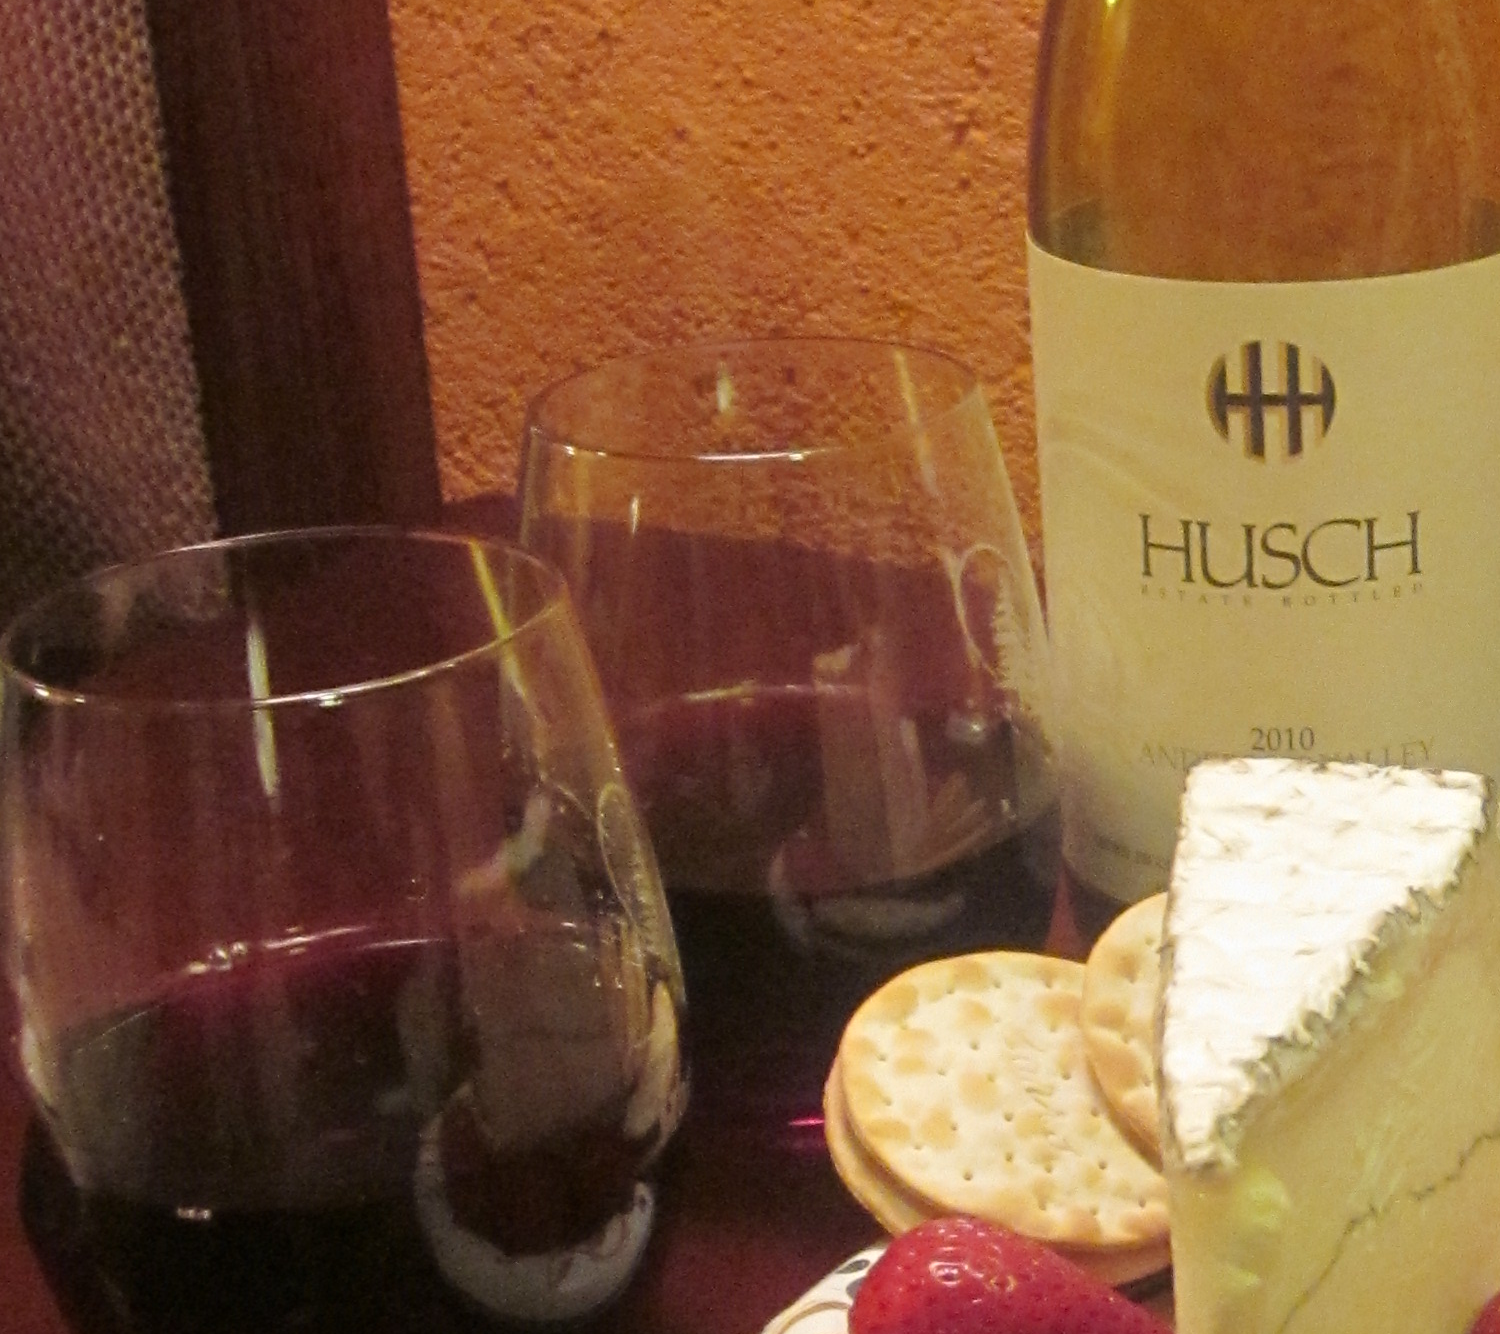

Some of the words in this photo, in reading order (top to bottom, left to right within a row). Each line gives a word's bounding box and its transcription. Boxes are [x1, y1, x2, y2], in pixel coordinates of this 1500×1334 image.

[1138, 510, 1423, 590] HUSCH
[1140, 583, 1253, 608] ESTATE
[1281, 581, 1424, 608] BOTTLED
[1250, 725, 1316, 752] 2010
